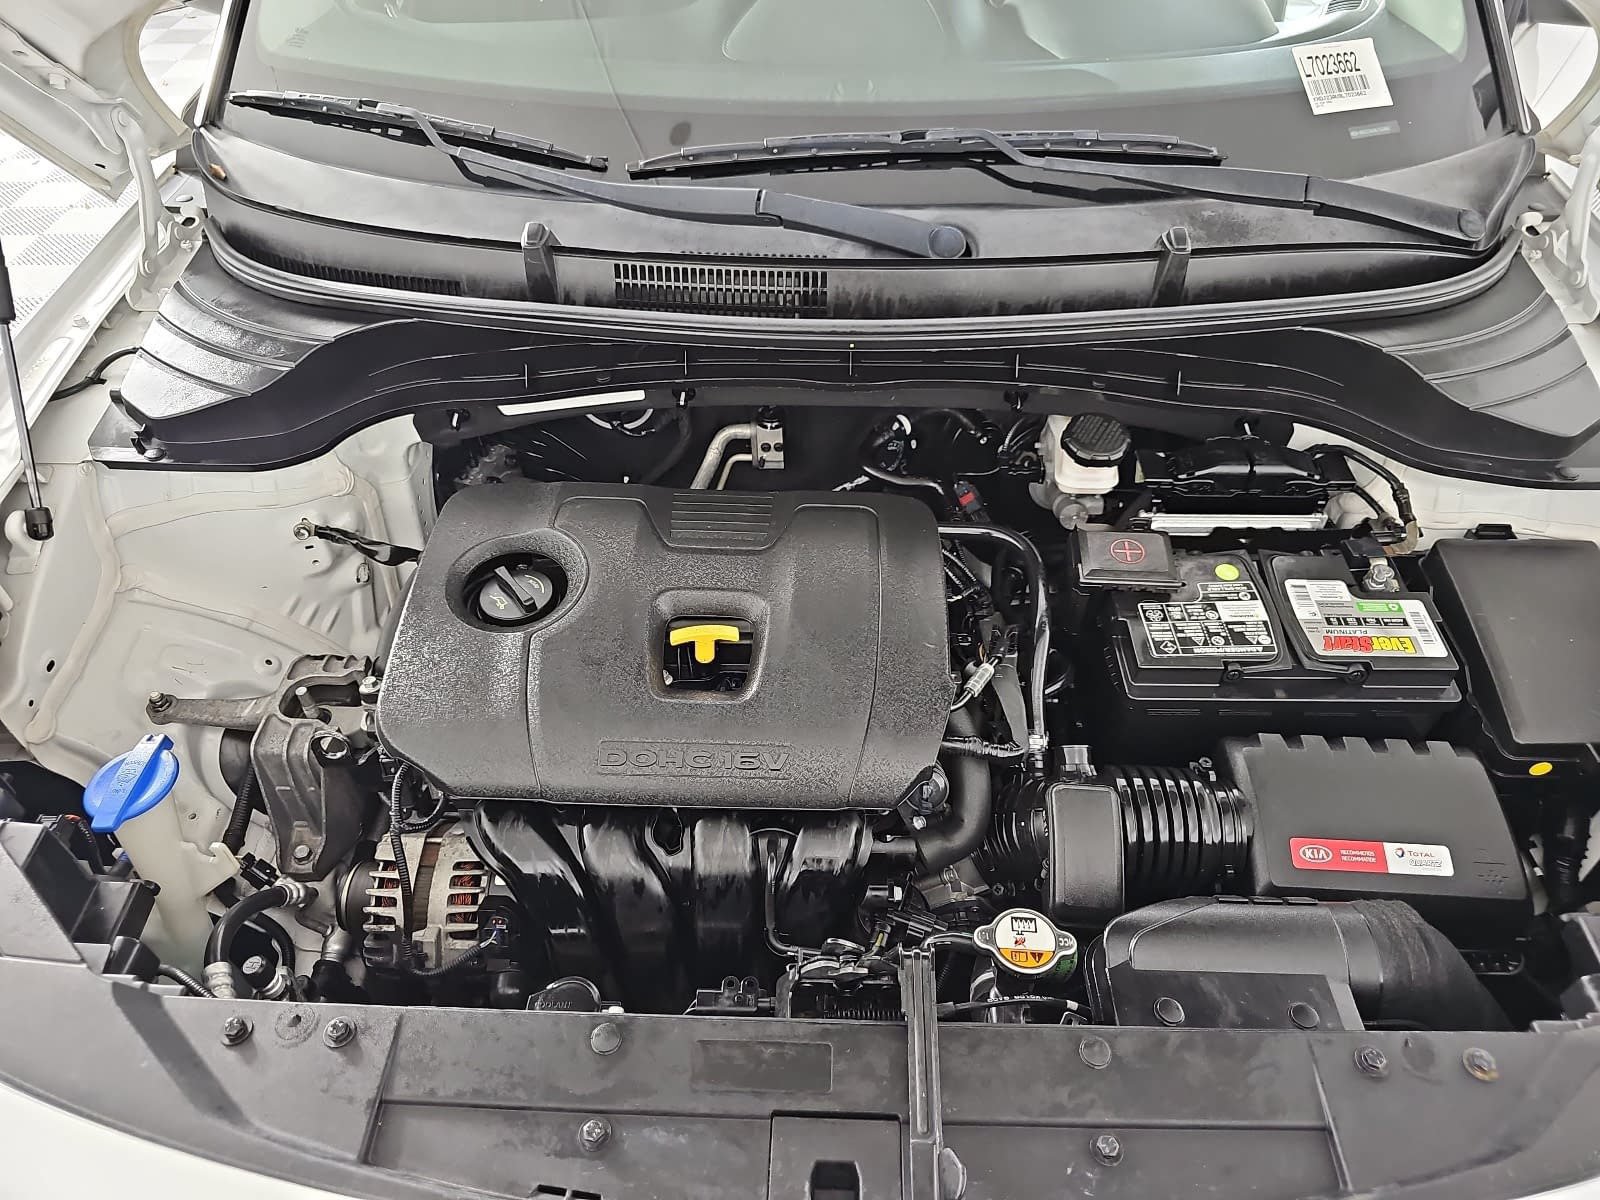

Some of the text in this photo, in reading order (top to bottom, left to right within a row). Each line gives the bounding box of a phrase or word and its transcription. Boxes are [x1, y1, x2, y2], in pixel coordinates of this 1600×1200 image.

[1299, 51, 1361, 78] L7023662
[1322, 635, 1417, 654] EverStart
[599, 749, 790, 772] DOHC 16V
[1304, 847, 1328, 861] KIA
[1408, 850, 1436, 858] TOTAL
